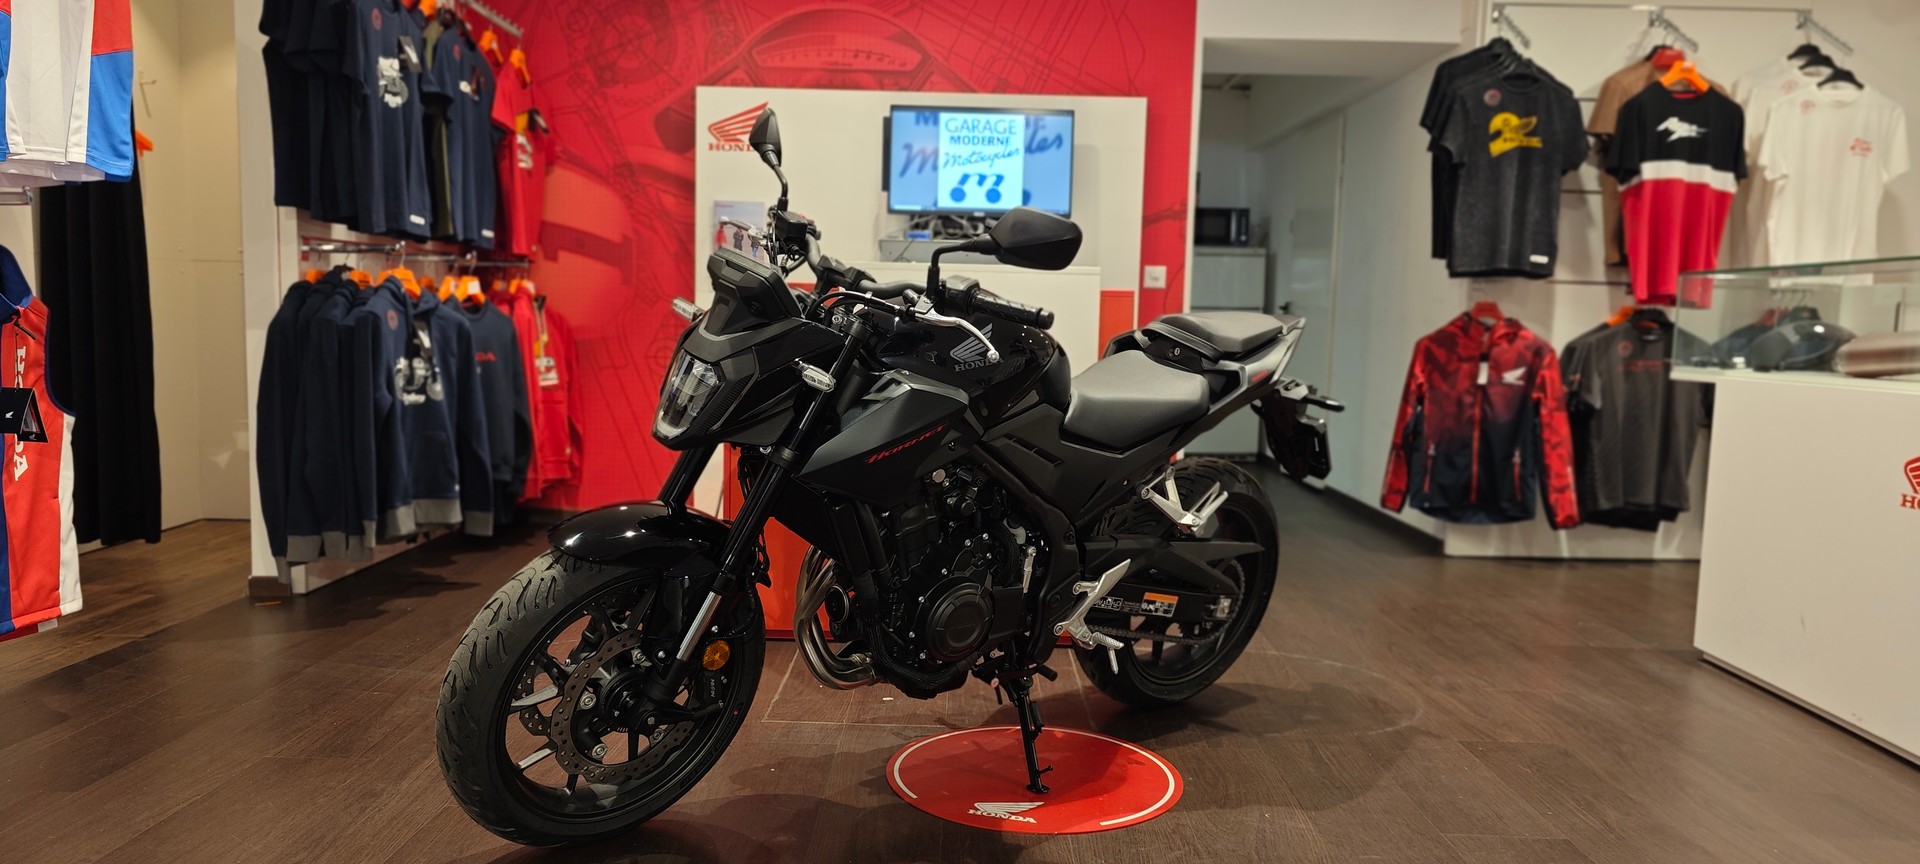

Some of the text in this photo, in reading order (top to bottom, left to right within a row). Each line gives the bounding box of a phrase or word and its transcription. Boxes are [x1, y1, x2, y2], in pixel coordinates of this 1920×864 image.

[945, 118, 1017, 135] GARAGE
[950, 136, 1011, 147] MODERNE
[14, 346, 29, 482] HODA
[967, 808, 1038, 824] HONDA
